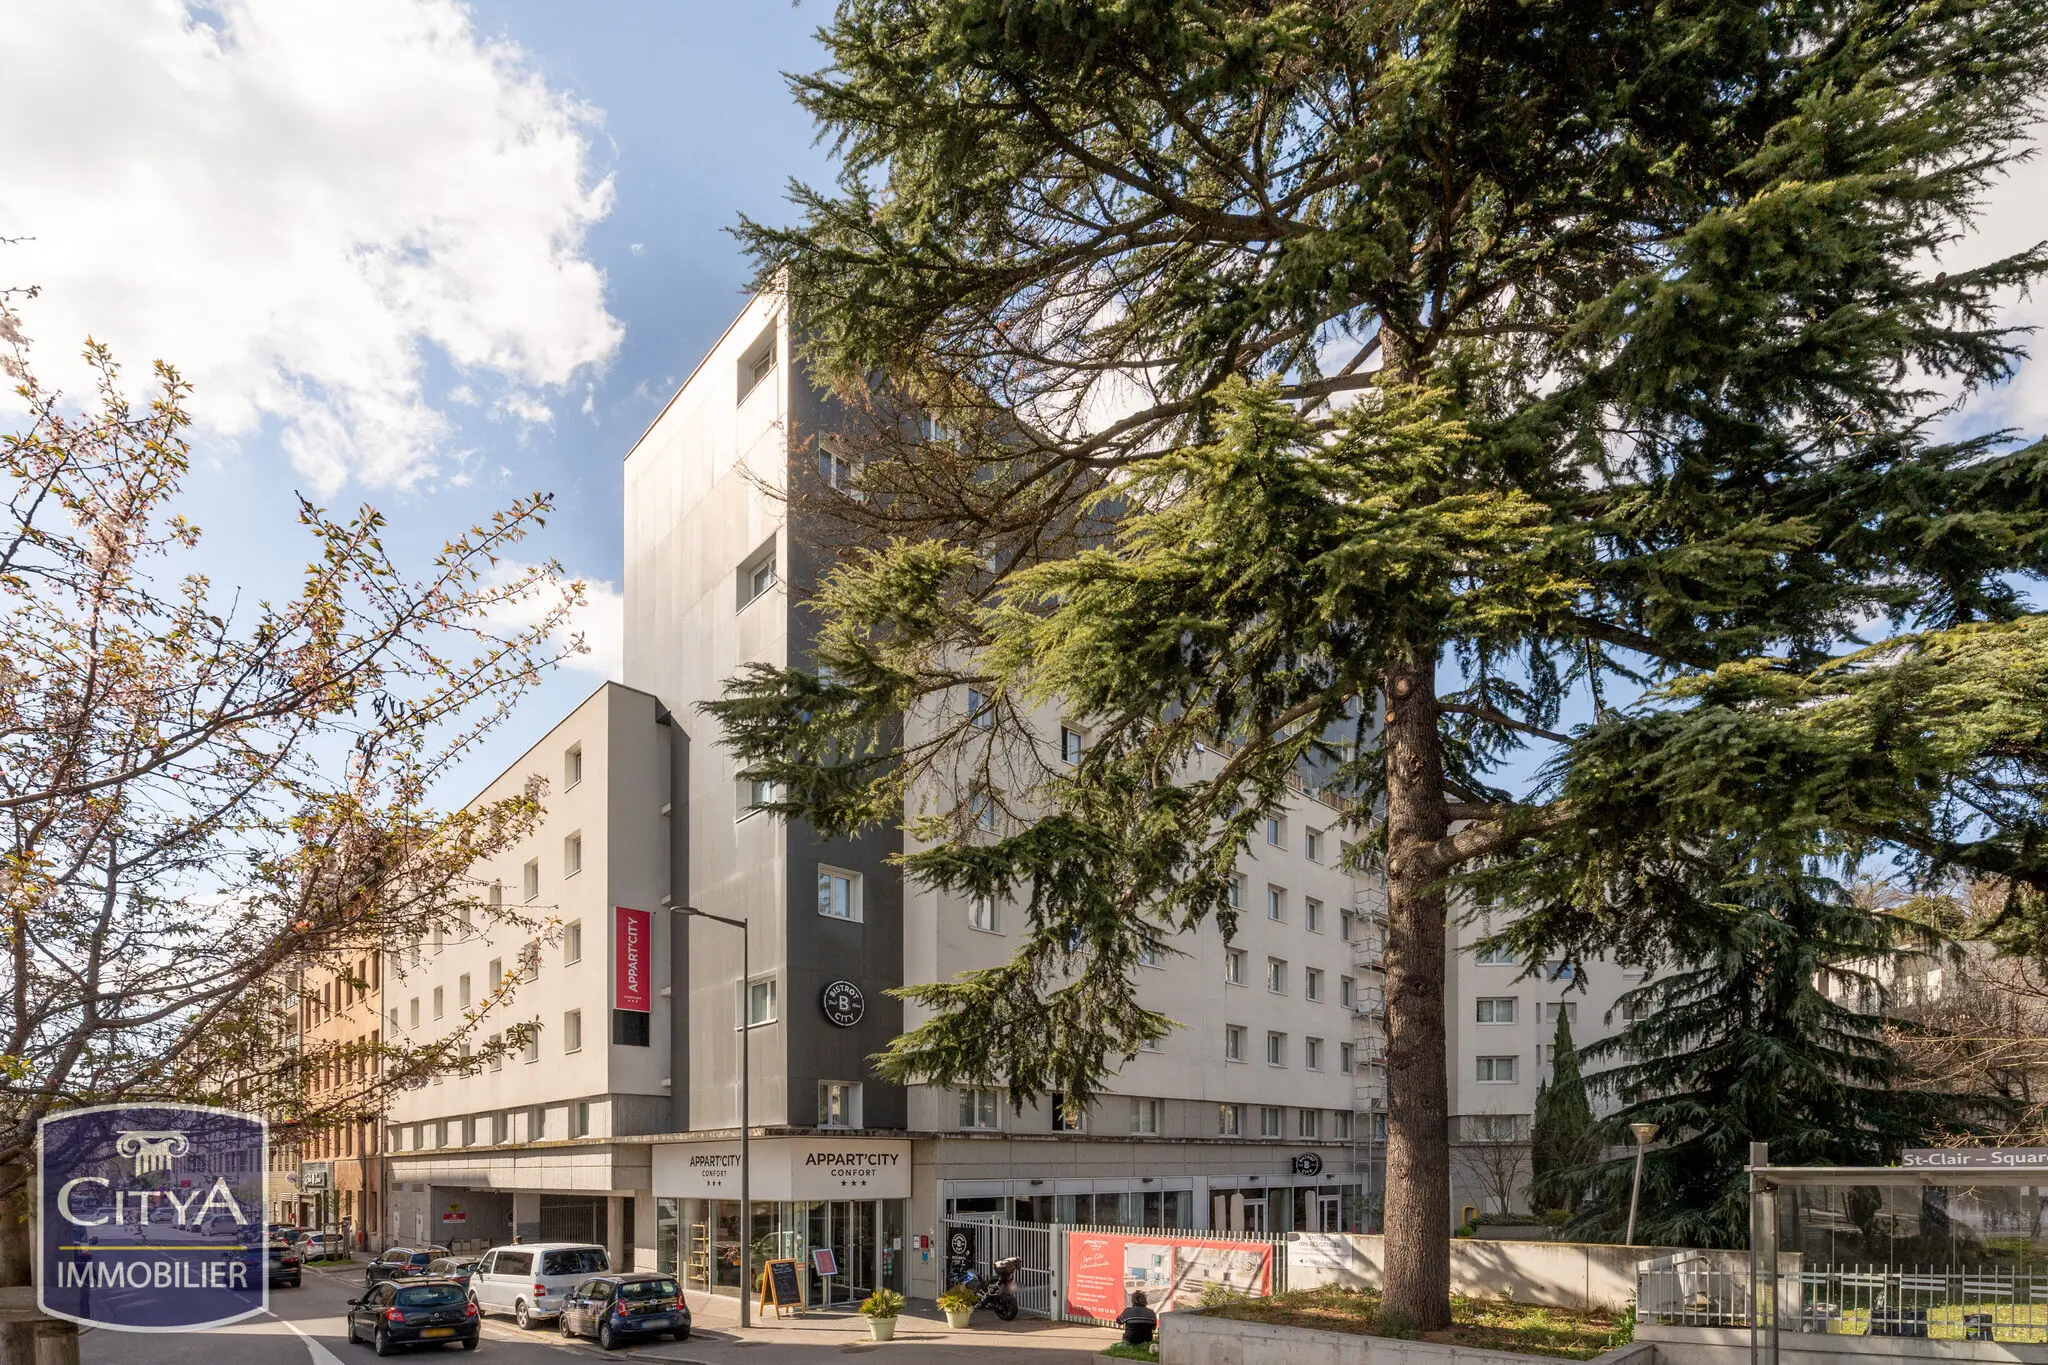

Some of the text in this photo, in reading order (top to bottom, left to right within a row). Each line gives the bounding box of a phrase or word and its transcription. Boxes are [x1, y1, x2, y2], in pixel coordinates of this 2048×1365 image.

[628, 917, 639, 993] APPART'CITY
[829, 984, 860, 1000] BISTROT
[839, 995, 849, 1010] B
[834, 1012, 855, 1023] CITY
[690, 1154, 742, 1168] APPART'CITY
[805, 1153, 899, 1167] APPART'CITY
[1903, 1153, 1971, 1166] St-Clair
[1991, 1151, 2048, 1167] Squar
[701, 1170, 728, 1178] CONFORT
[831, 1169, 877, 1178] CONFORT
